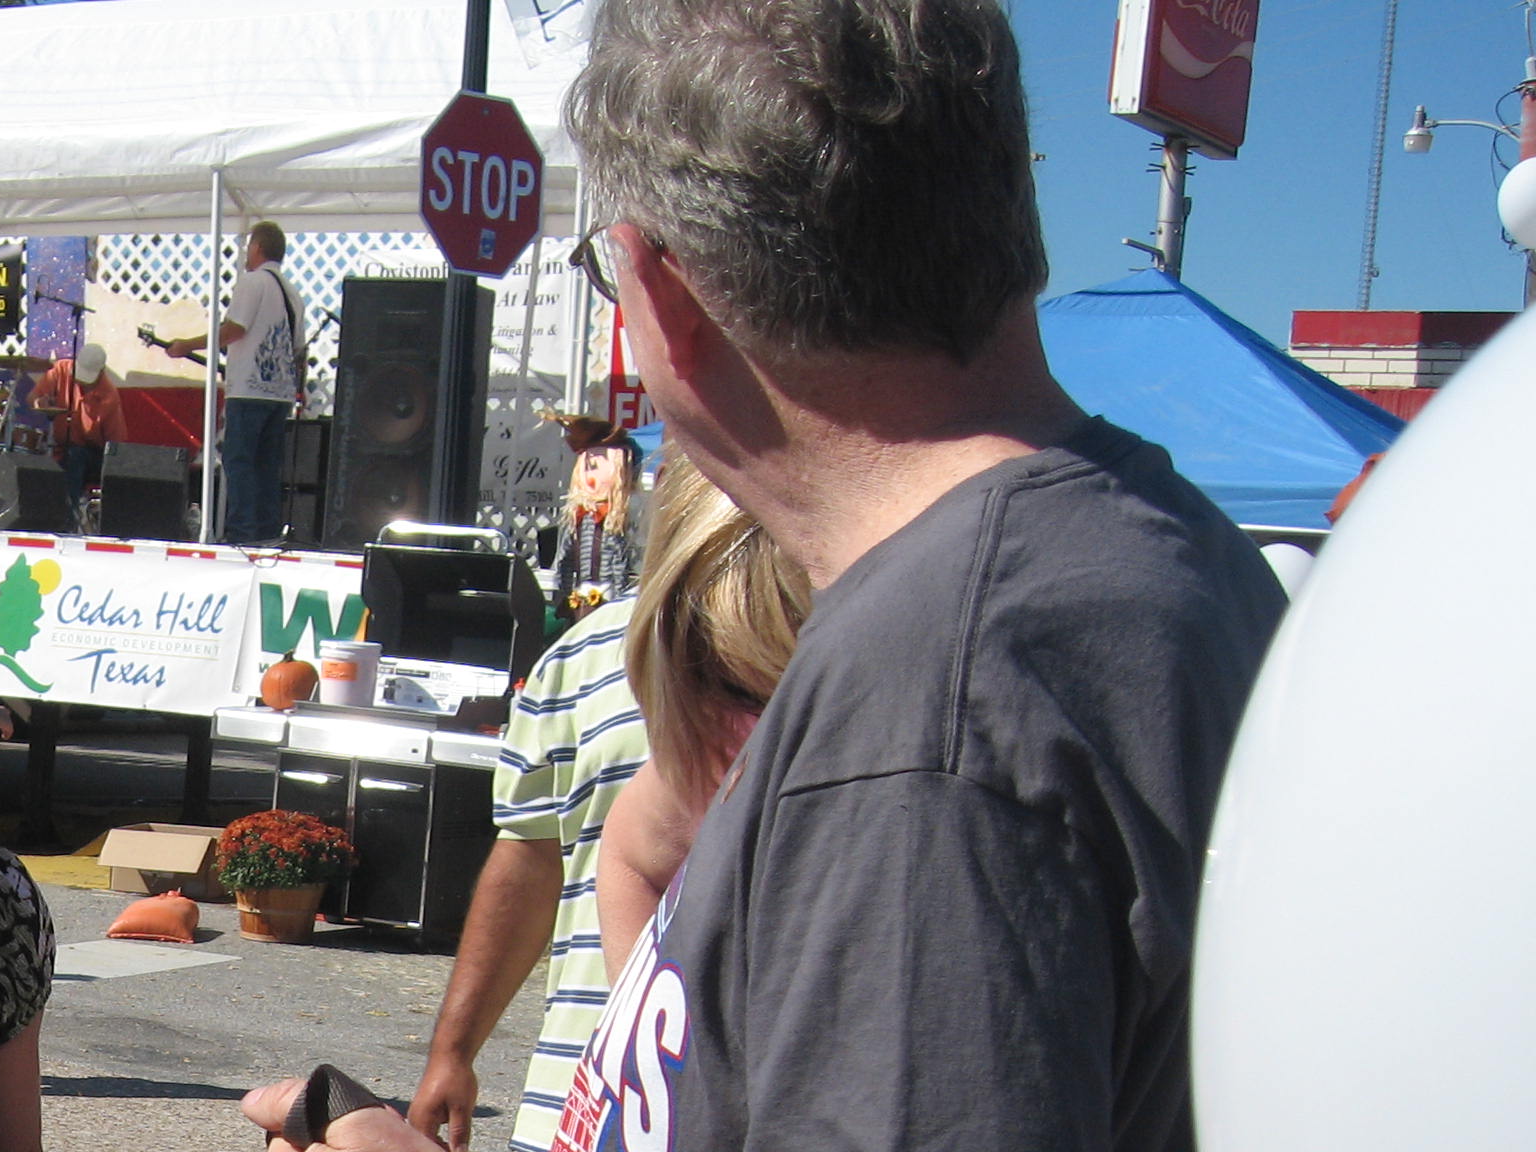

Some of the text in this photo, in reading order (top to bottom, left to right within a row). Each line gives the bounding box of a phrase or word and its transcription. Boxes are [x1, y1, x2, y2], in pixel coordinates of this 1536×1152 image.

[429, 146, 535, 222] STOP
[57, 585, 228, 635] Cedar Hill
[51, 632, 221, 656] ECONOMIC DEVELOPMENT
[66, 648, 166, 694] Texas
